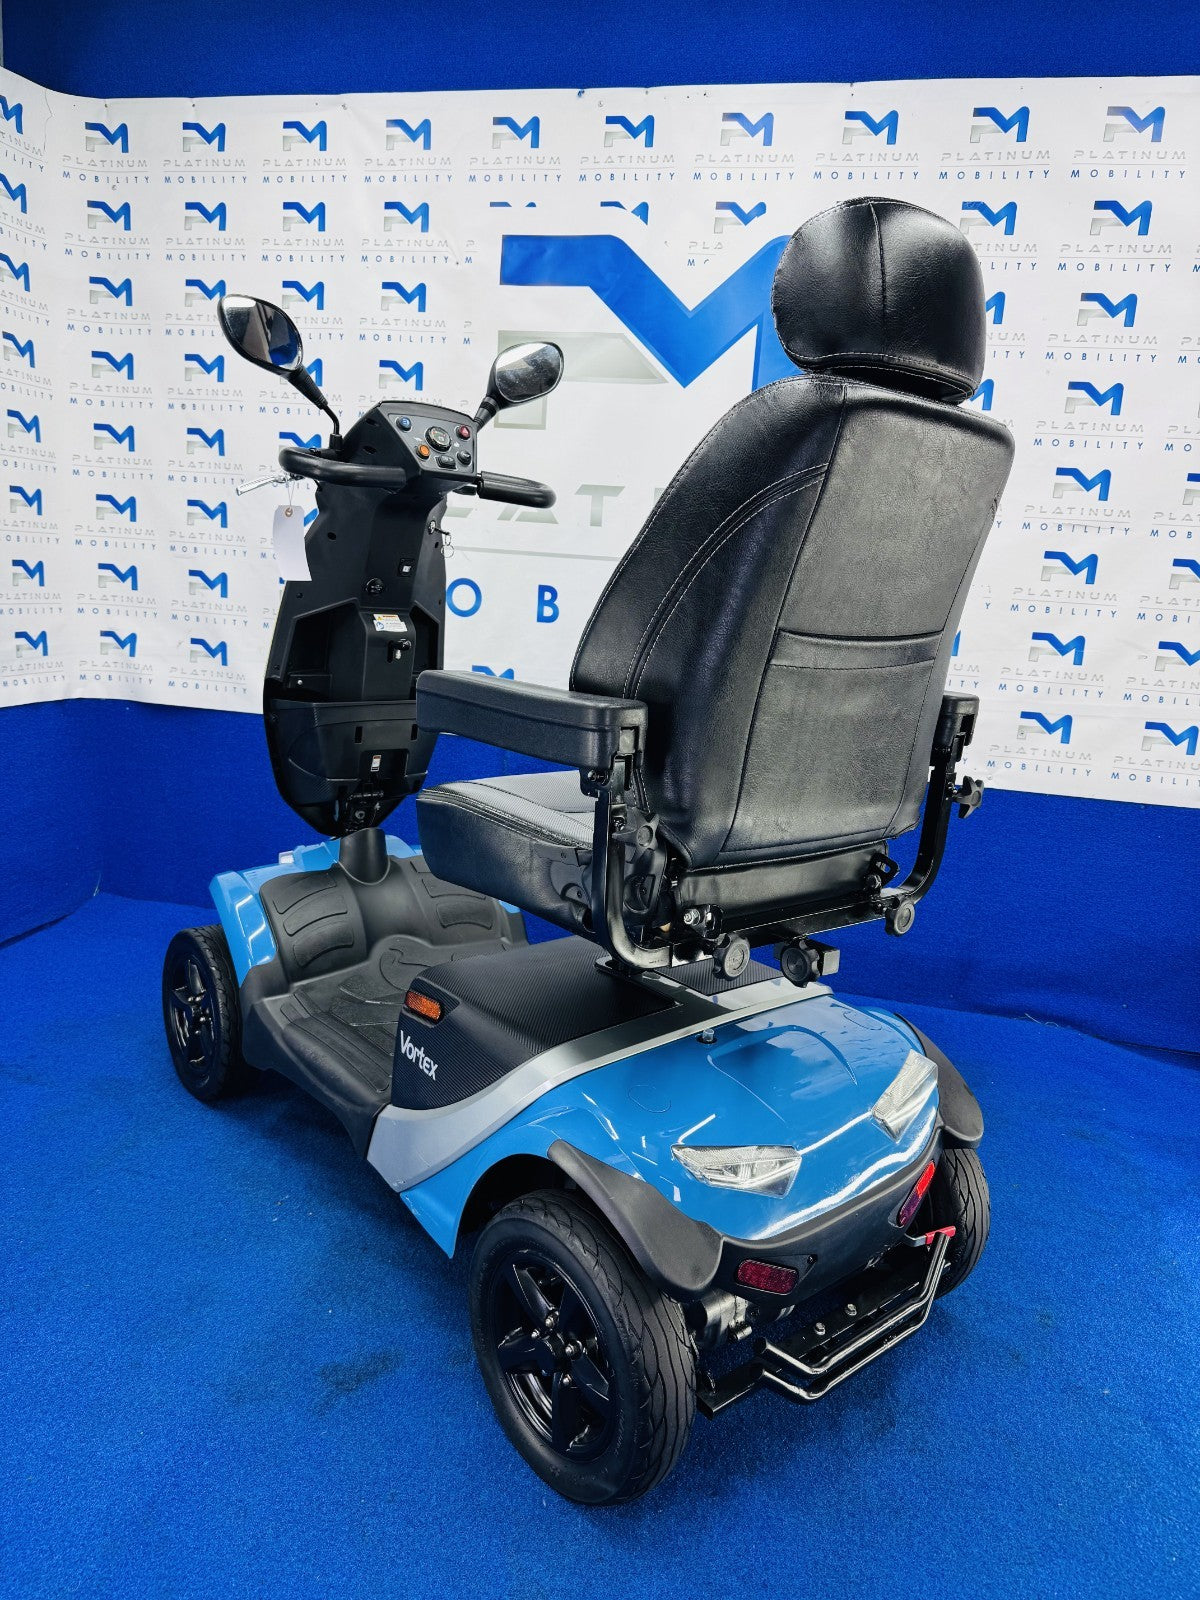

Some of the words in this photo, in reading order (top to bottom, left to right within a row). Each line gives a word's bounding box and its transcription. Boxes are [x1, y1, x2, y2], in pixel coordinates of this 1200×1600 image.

[580, 154, 674, 165] PLATINUM
[695, 153, 794, 163] PLATINUM
[816, 152, 918, 162] PLATINUM
[941, 150, 1050, 161] PLATINUM
[1074, 149, 1186, 160] PLATINUM
[63, 155, 147, 169] PLATINUM
[163, 158, 245, 168] PLATINUM
[263, 157, 346, 168] PLATINUM
[365, 156, 451, 167] PLATINUM
[470, 155, 560, 166] PLATINUM
[63, 171, 149, 183] MOBILITY
[263, 174, 347, 184] MOBILITY
[365, 174, 452, 183] MOBILITY
[469, 173, 561, 183] MOBILITY
[579, 172, 674, 182] MOBILITY
[694, 171, 794, 181] MOBILITY
[814, 170, 918, 180] MOBILITY
[939, 169, 1049, 180] MOBILITY
[1071, 168, 1185, 179] MOBILITY
[165, 175, 246, 184] MOBILITY
[65, 233, 148, 244] PLATINUM
[166, 237, 245, 246] PLATINUM
[262, 238, 344, 247] PLATINUM
[362, 238, 448, 248] PLATINUM
[974, 243, 1037, 252] TINUM
[1061, 243, 1171, 254] PLATINUM
[65, 248, 150, 260] MOBILITY
[166, 253, 246, 262] MOBILITY
[262, 254, 344, 263] MOBILITY
[361, 254, 448, 264] MOBILITY
[1058, 262, 1170, 273] MOBILITY
[67, 308, 150, 320] PLATINUM
[295, 317, 343, 325] TINUM
[360, 317, 446, 328] PLATINUM
[67, 324, 151, 335] MOBILITY
[359, 333, 446, 344] MOBILITY
[1048, 334, 1157, 344] PLATINUM
[1045, 352, 1156, 362] MOBILITY
[1, 383, 53, 400] OBILITY
[70, 382, 152, 394] PLATINUM
[168, 387, 243, 398] PLATINUM
[70, 397, 153, 408] MOBILITY
[168, 402, 244, 412] MOBILITY
[1036, 421, 1143, 432] PLATINUM
[1034, 439, 1143, 449] MOBILITY
[72, 454, 151, 465] PLATINUM
[168, 460, 243, 470] PLATINUM
[2, 459, 56, 473] OBILITY
[73, 469, 153, 480] MOBILITY
[168, 475, 245, 485] MOBILITY
[1025, 505, 1131, 518] PLATINUM
[75, 525, 154, 536] PLATINUM
[1022, 522, 1130, 535] MOBILITY
[169, 531, 245, 542] PLATINUM
[75, 539, 156, 550] MOBILITY
[170, 545, 247, 557] MOBILITY
[77, 593, 156, 604] PLATINUM
[1013, 588, 1117, 602] PLATINUM
[171, 600, 246, 612] PLATINUM
[1010, 604, 1117, 618] MOBILITY
[77, 608, 157, 618] MOBILITY
[1137, 613, 1191, 623] MOBI
[171, 614, 248, 626] MOBILITY
[79, 660, 152, 672] PLATINUM
[80, 674, 152, 684] MOBILITY
[168, 667, 246, 680] PLATINUM
[1001, 667, 1103, 681] PLATINUM
[168, 681, 247, 694] MOBILITY
[999, 684, 1103, 698] MOBILITY
[990, 745, 1090, 760] PLATINUM
[987, 760, 1091, 776] MOBILITY
[400, 1029, 439, 1081] Vortex
